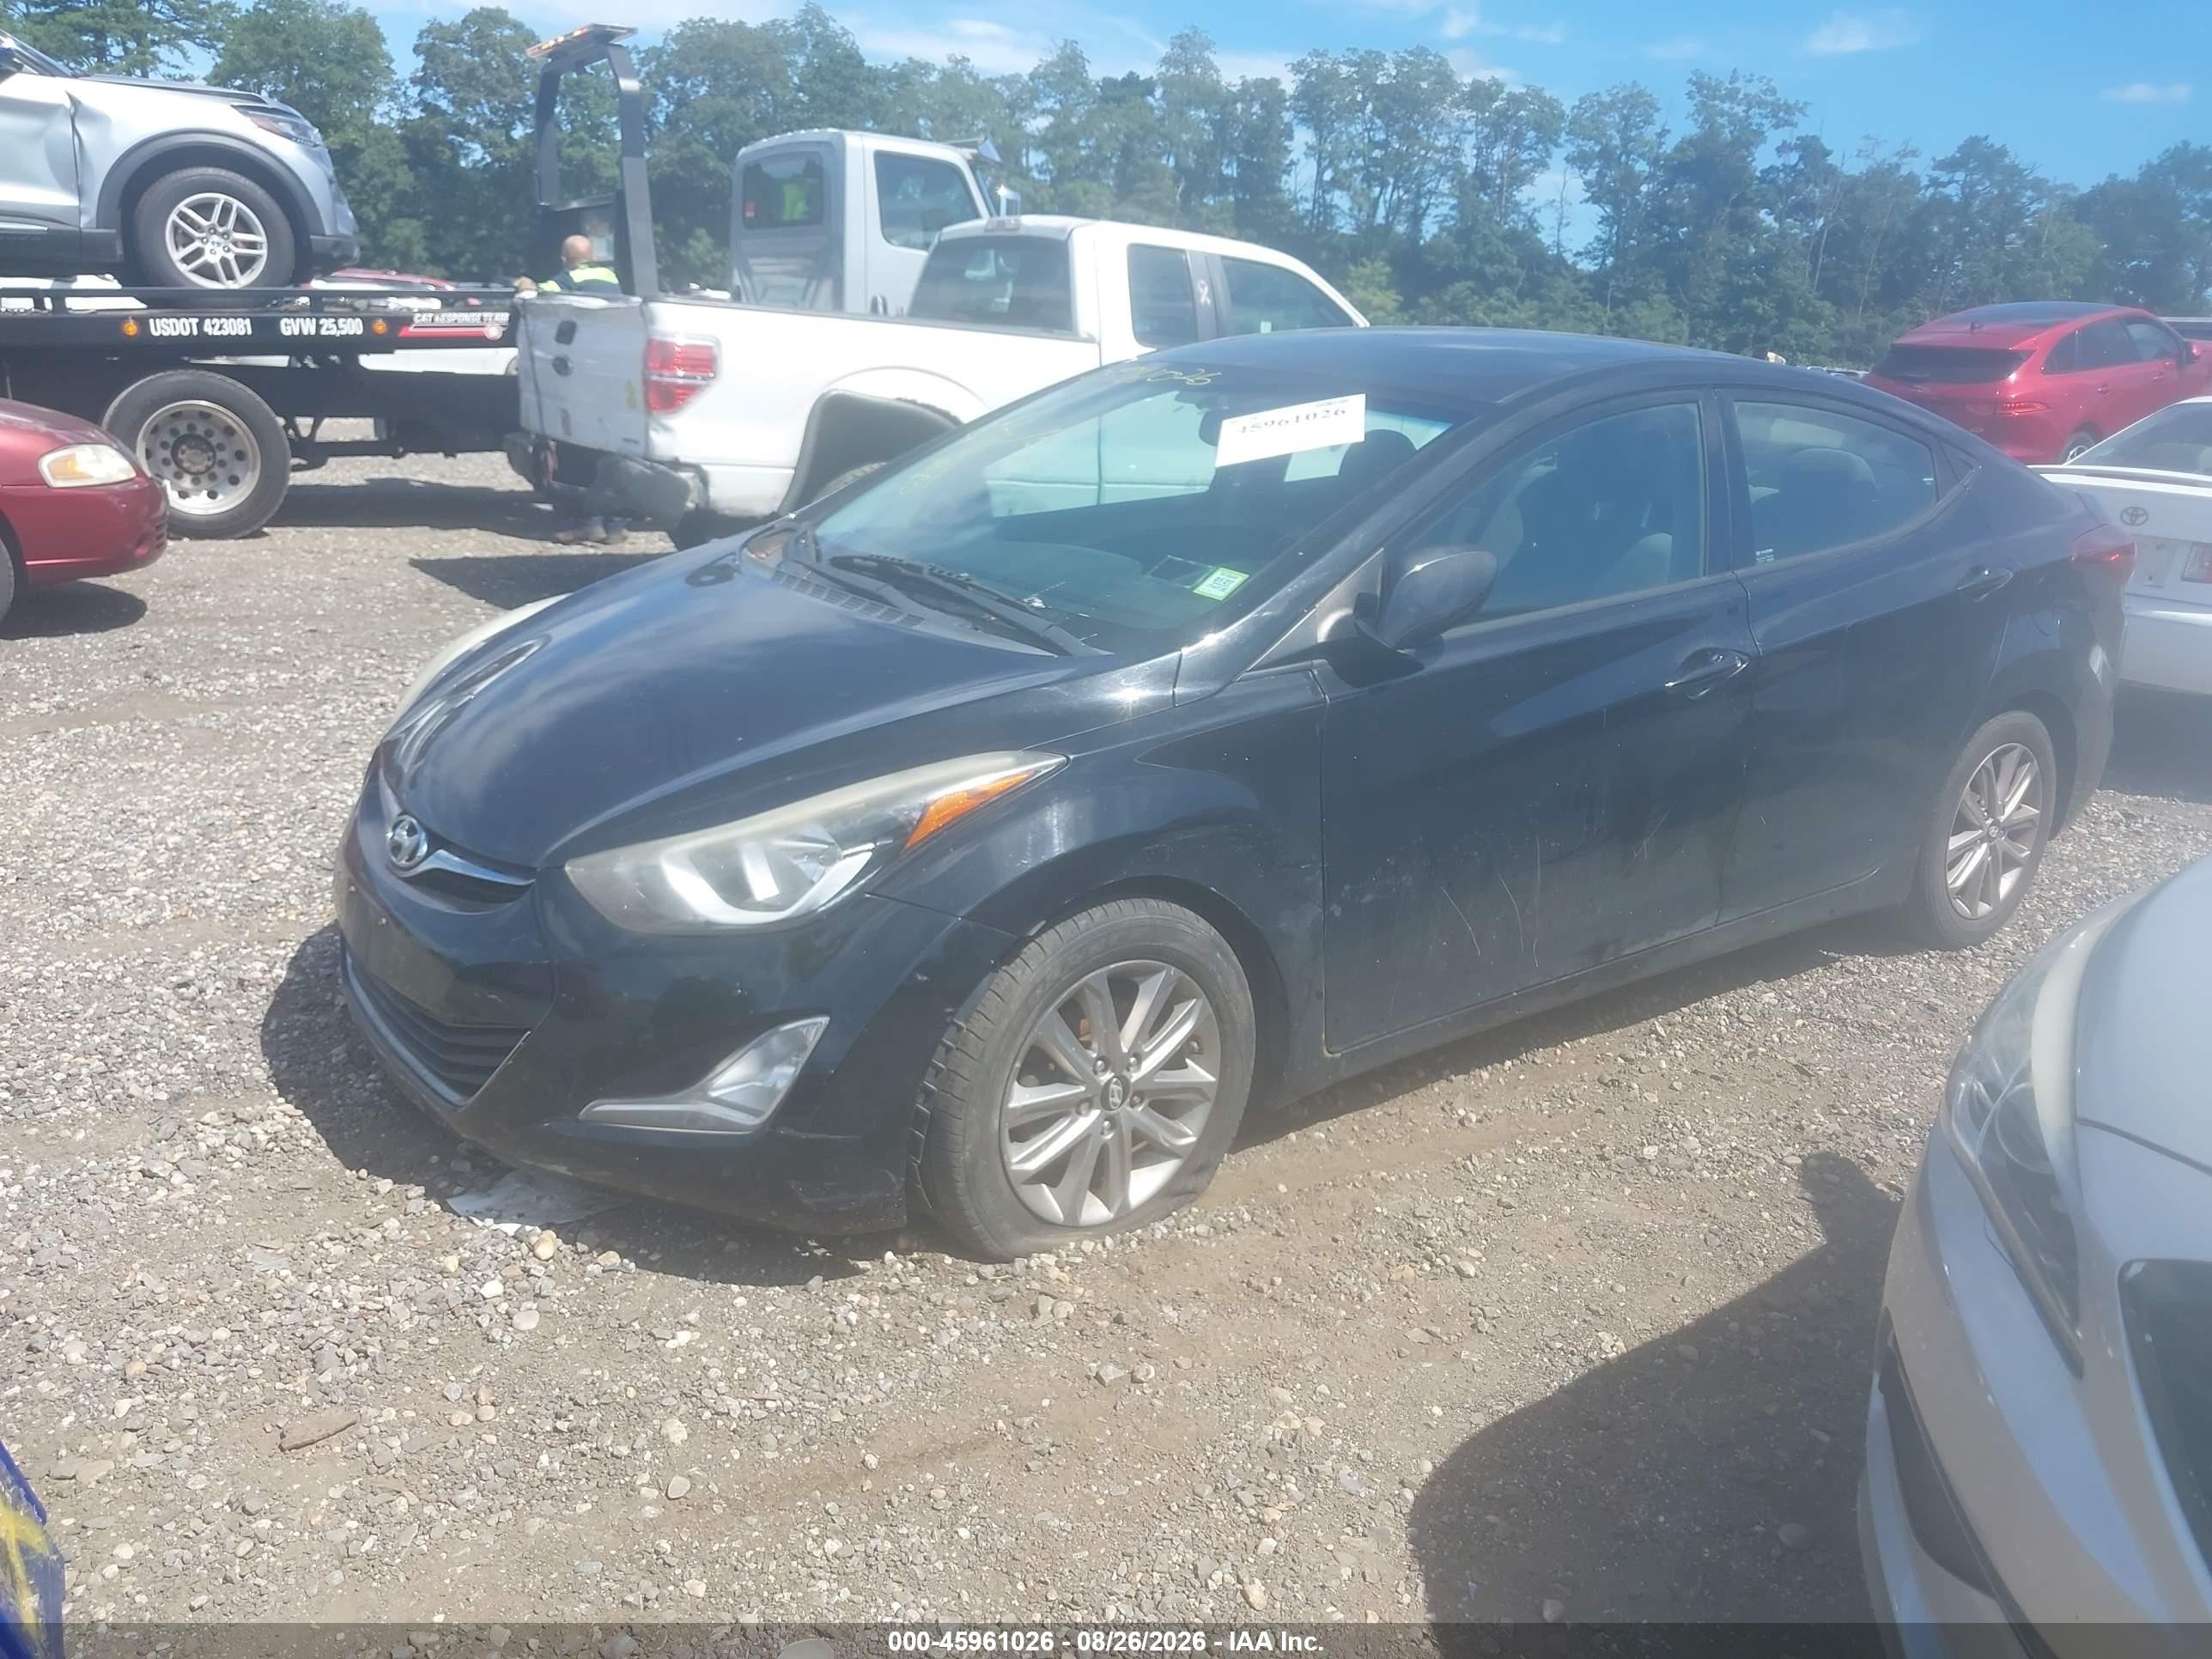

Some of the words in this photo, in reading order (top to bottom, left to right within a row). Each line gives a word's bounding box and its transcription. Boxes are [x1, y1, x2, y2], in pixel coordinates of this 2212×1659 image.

[149, 318, 199, 336] USDOT
[204, 318, 252, 336] 423081
[280, 318, 316, 336] GVW
[319, 318, 363, 337] 25,500
